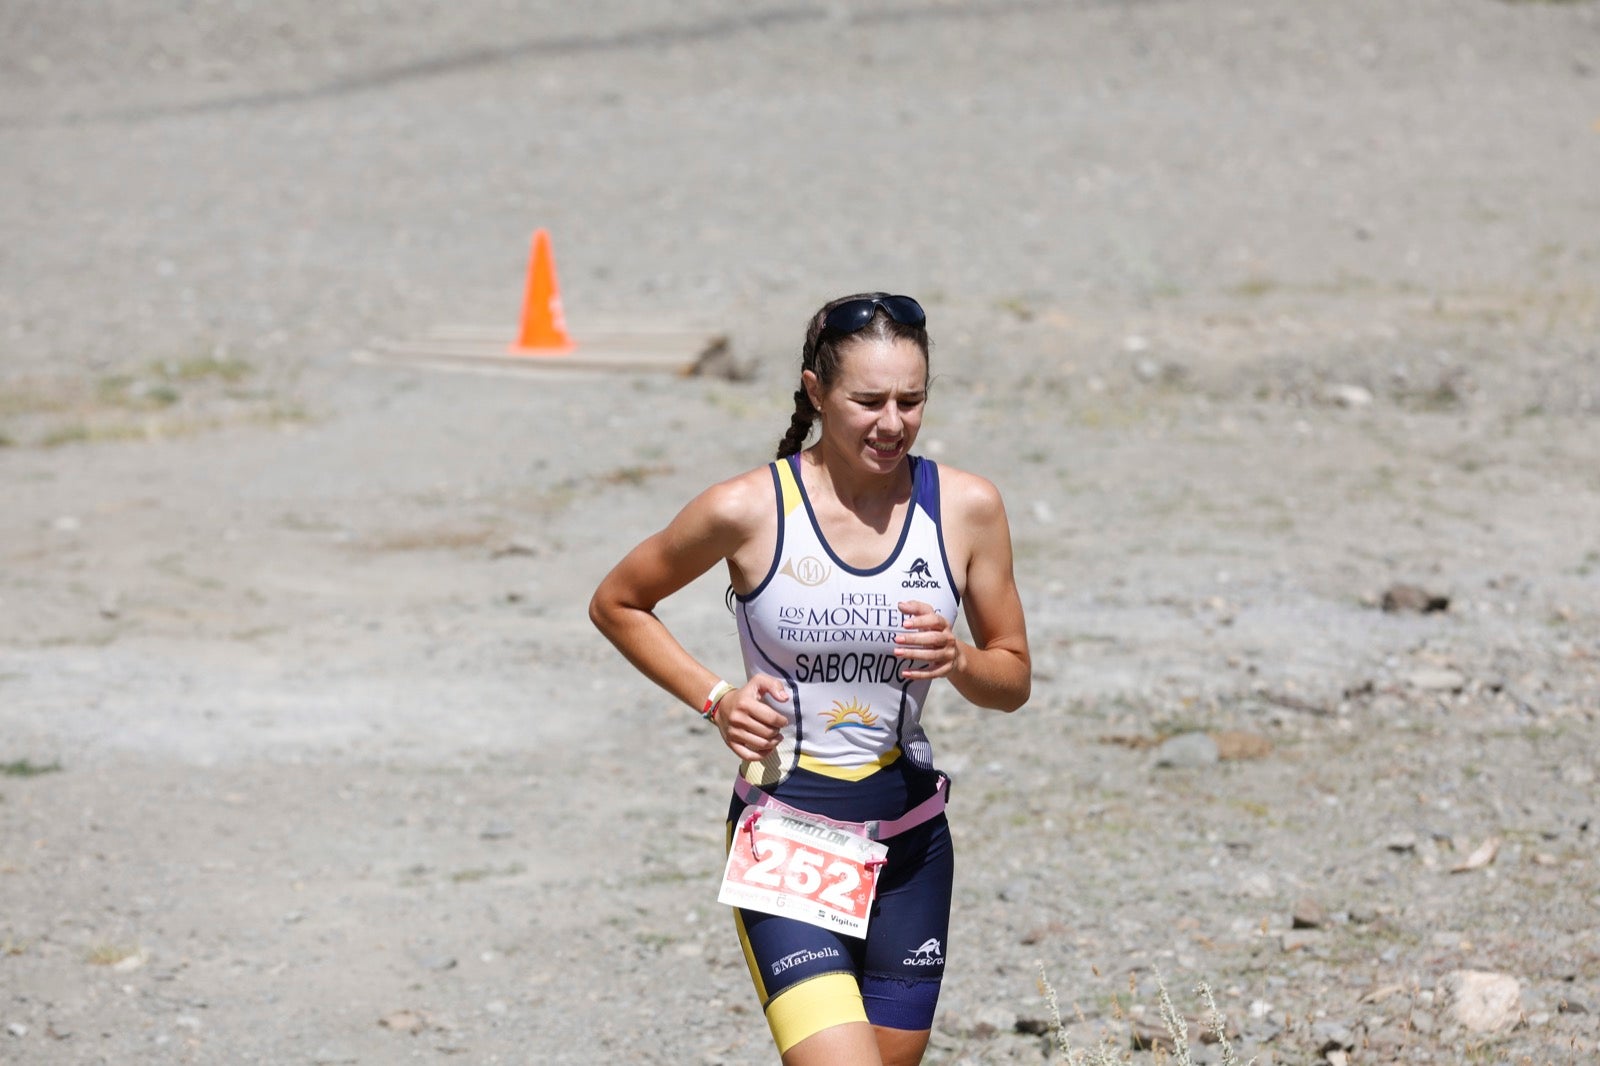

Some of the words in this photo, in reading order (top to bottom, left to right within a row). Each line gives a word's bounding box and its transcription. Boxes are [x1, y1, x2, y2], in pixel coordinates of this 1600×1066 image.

[902, 580, 941, 589] austral
[841, 593, 891, 606] HOTEL
[779, 606, 805, 620] LOS
[778, 628, 856, 643] TRIATLON
[781, 816, 850, 846] TRIATLON
[742, 839, 860, 911] 252
[781, 947, 839, 971] Marbella
[903, 957, 944, 966] austra
